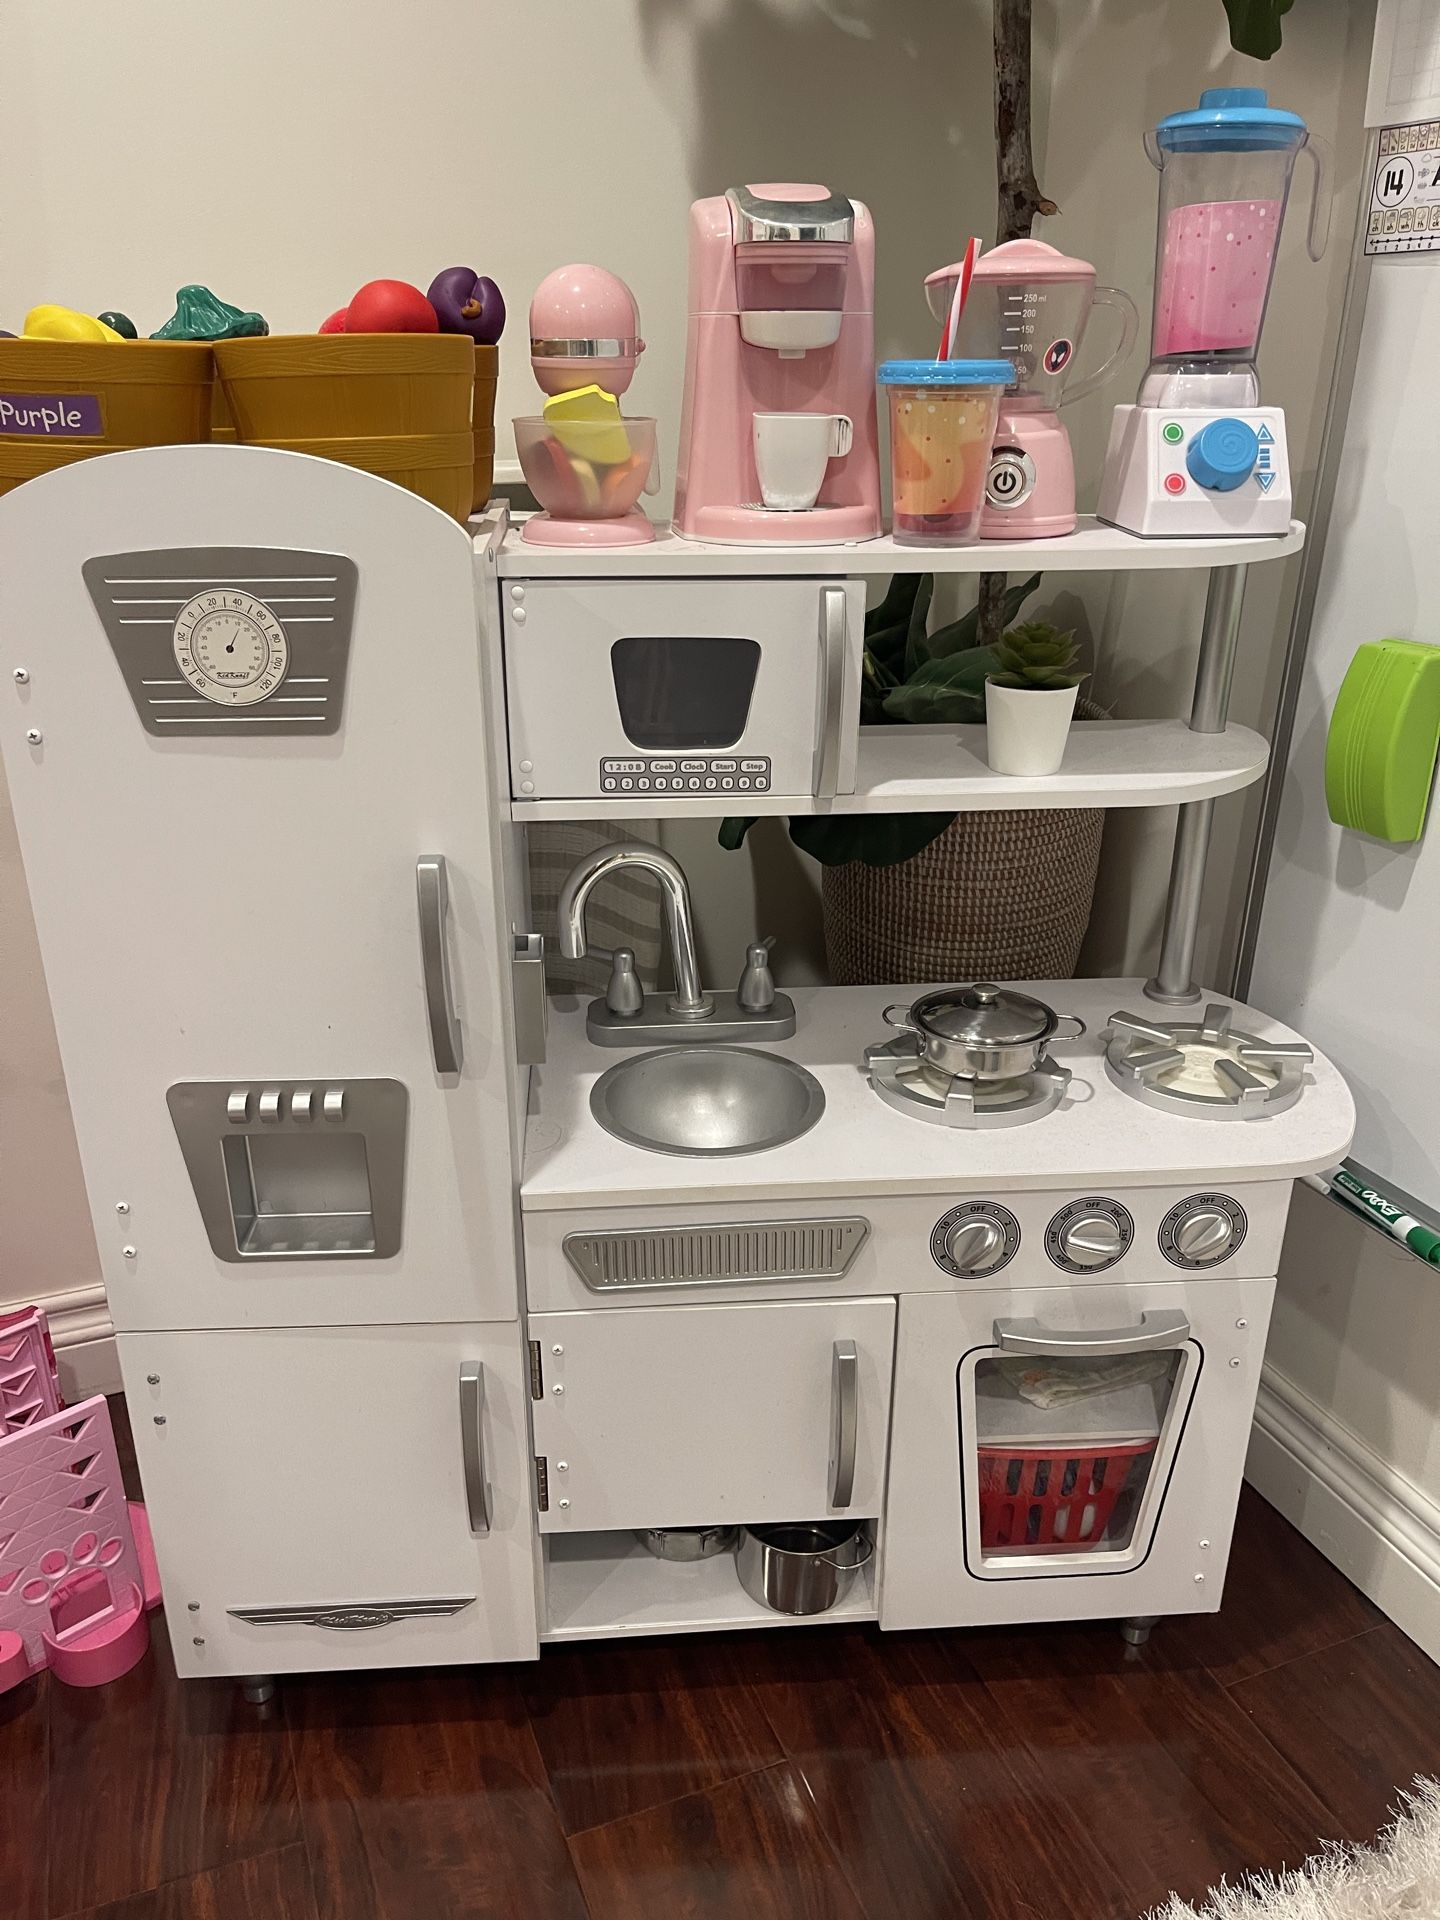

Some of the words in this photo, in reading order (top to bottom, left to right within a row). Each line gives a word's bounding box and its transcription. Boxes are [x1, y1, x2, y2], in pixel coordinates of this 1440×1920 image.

[1384, 169, 1404, 196] 14
[1024, 294, 1038, 302] 250
[1020, 325, 1034, 333] 150
[1020, 344, 1032, 352] 100
[1018, 366, 1027, 374] 50
[0, 399, 82, 432] Purple
[206, 598, 216, 606] 20
[232, 598, 242, 606] 40
[256, 611, 267, 620] 60
[272, 633, 281, 643] 80
[182, 658, 189, 667] 40
[273, 657, 283, 670] 100
[195, 678, 205, 688] 60
[260, 679, 272, 690] 120
[746, 763, 763, 771] Stop
[1362, 1190, 1403, 1216] EXPO
[1170, 1212, 1179, 1221] 10
[941, 1221, 949, 1229] 10
